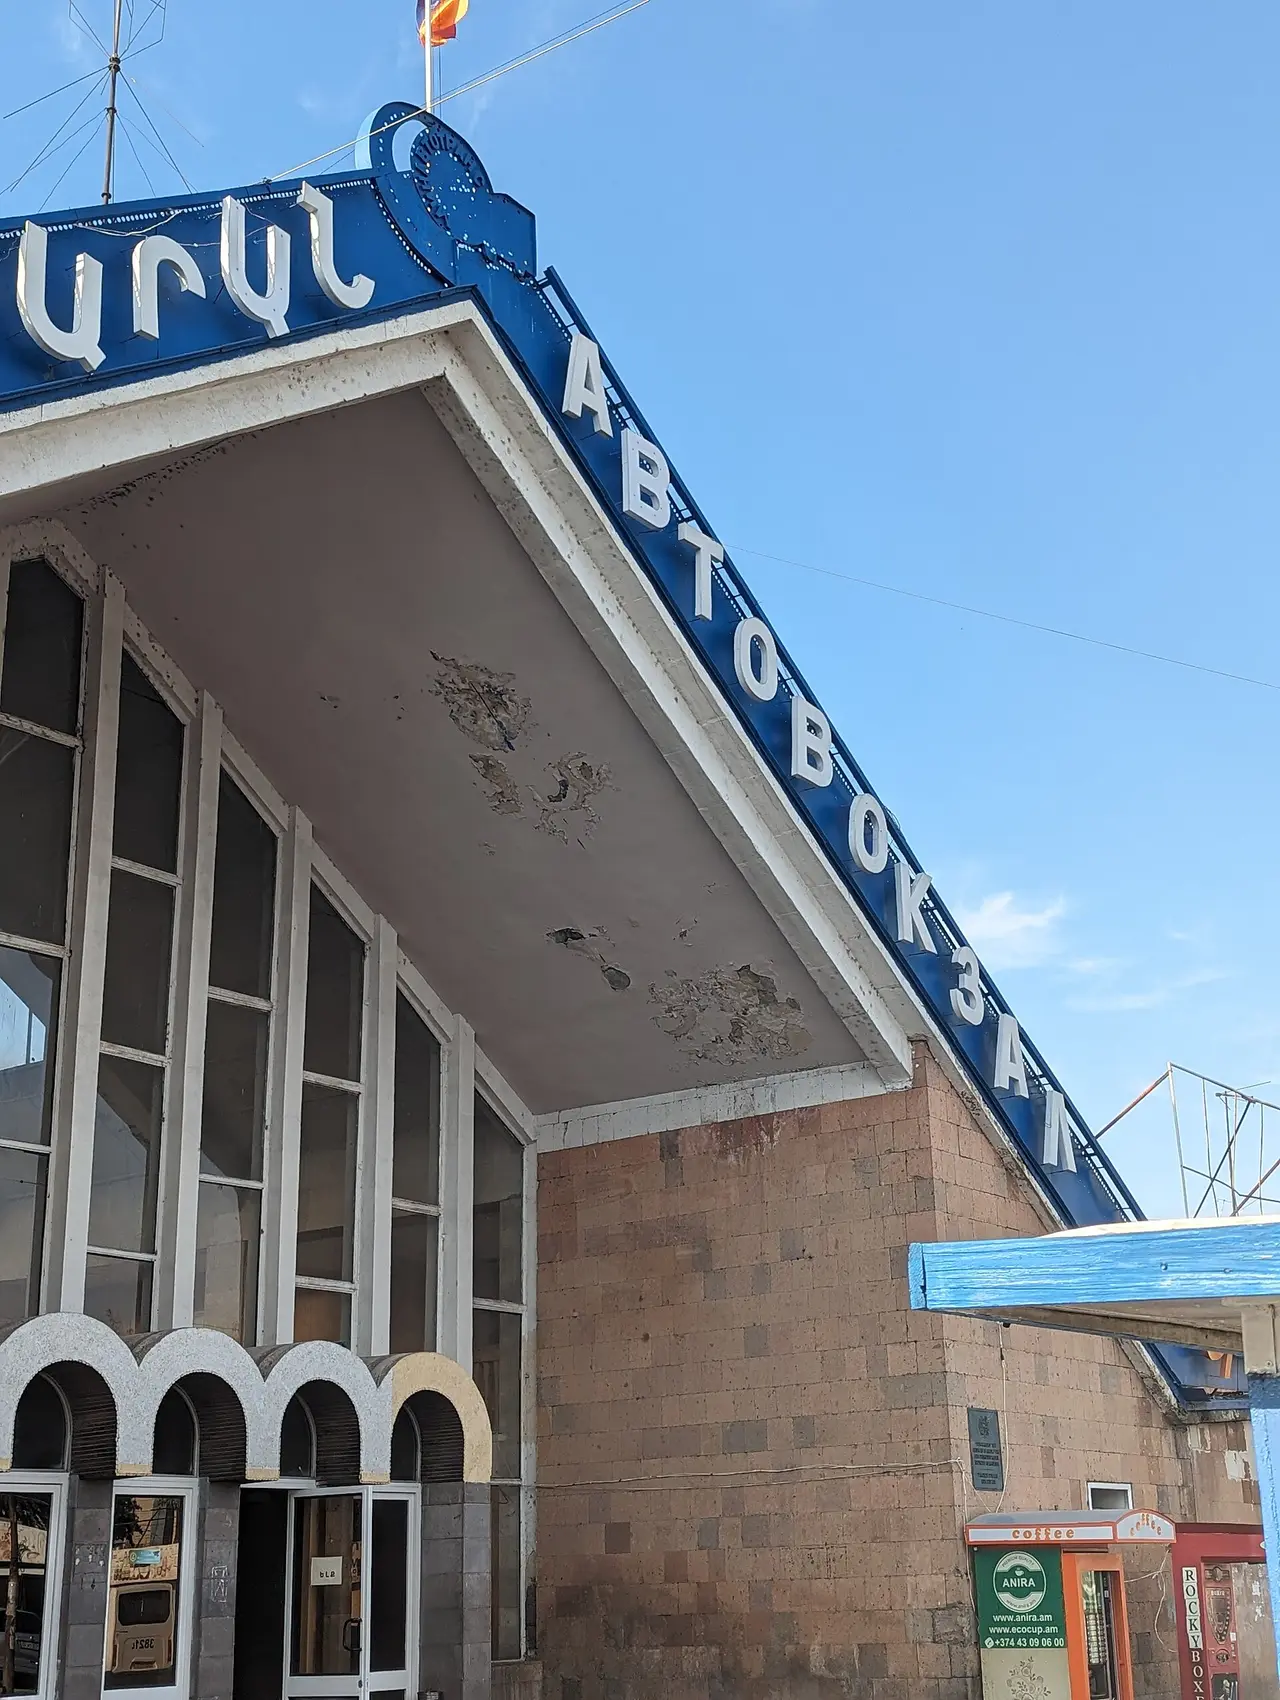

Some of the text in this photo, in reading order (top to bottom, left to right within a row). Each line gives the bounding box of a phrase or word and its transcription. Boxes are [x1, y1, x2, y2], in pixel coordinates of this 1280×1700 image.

[561, 333, 1077, 1174] АВТОВОКЗАЛ
[1130, 1513, 1162, 1536] coffee
[1011, 1528, 1075, 1541] coffee
[1002, 1577, 1036, 1588] ANIRA
[992, 1613, 1053, 1623] www.anira.am
[988, 1625, 1059, 1636] www.ecocup.am
[994, 1637, 1065, 1647] +374 43 09 06 00
